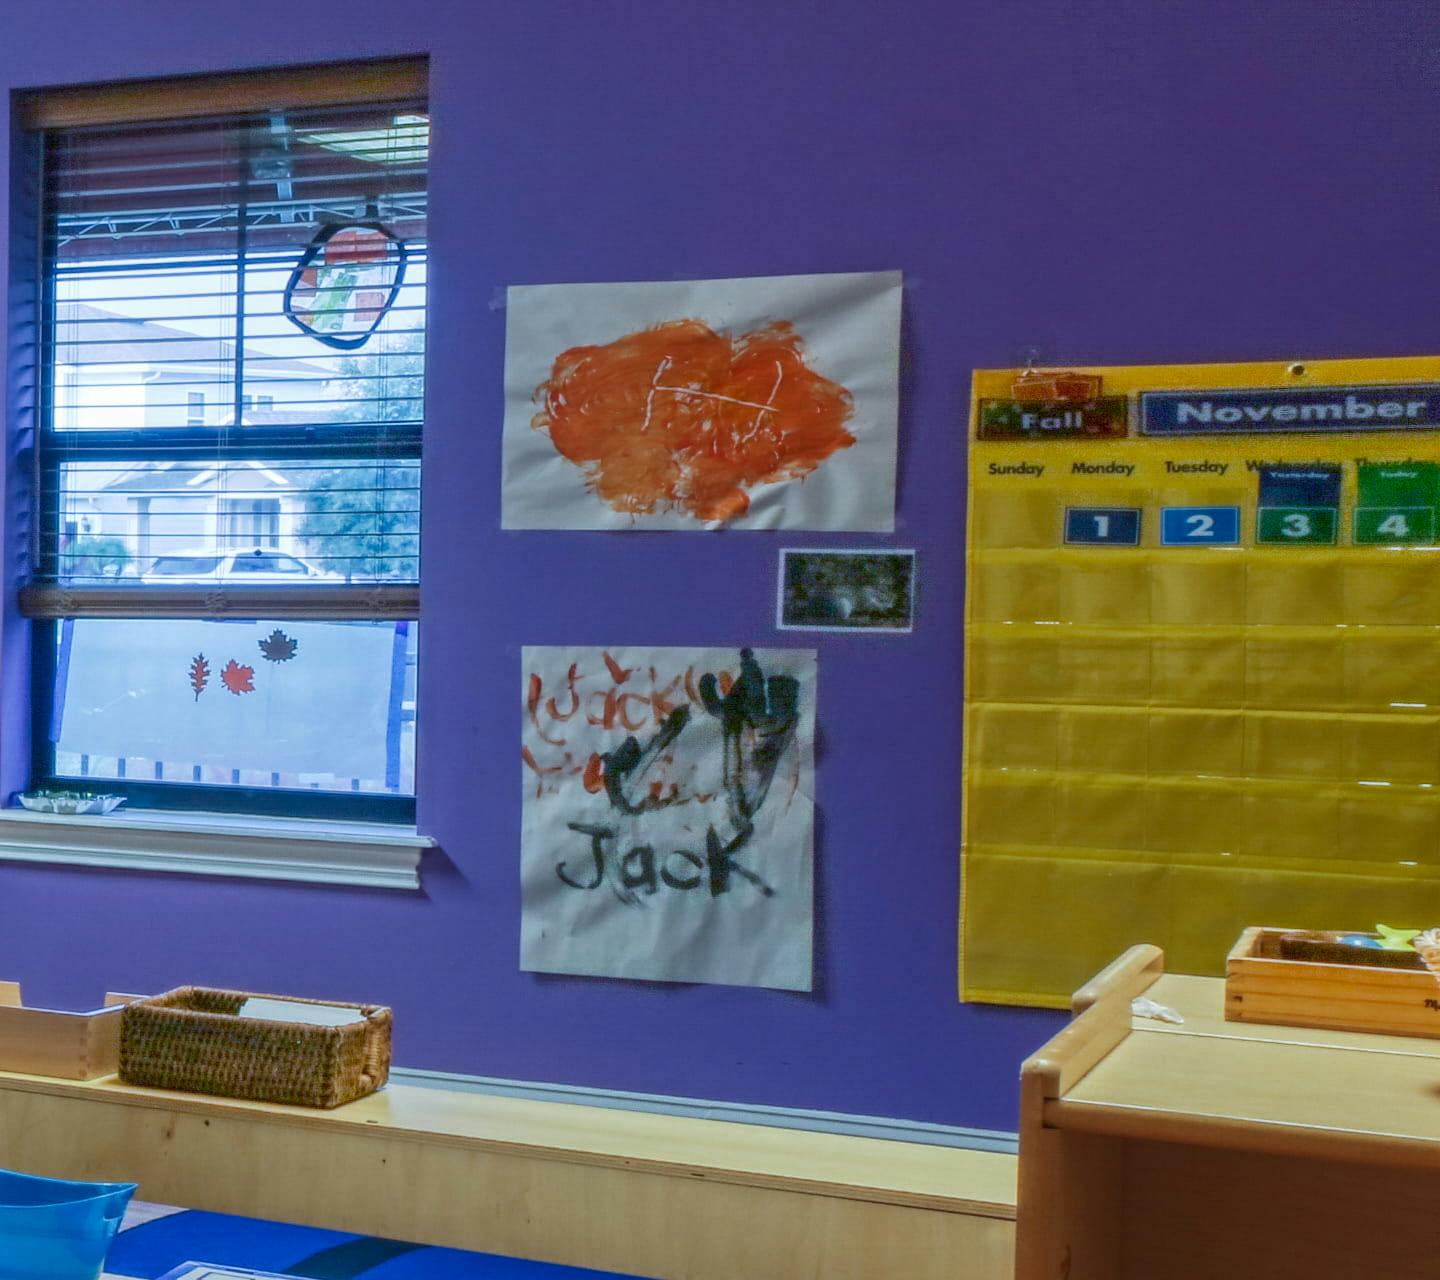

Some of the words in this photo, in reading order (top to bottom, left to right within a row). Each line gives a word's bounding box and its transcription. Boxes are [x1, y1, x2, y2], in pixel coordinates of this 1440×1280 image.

[1176, 395, 1427, 423] November
[1021, 411, 1082, 430] Fall
[988, 462, 1045, 477] Sunday
[1071, 461, 1135, 477] Monday
[1164, 460, 1229, 476] Tuesday
[1094, 515, 1110, 538] 1
[1186, 514, 1215, 538] 2
[1281, 513, 1312, 538] 3
[1376, 514, 1410, 538] 4
